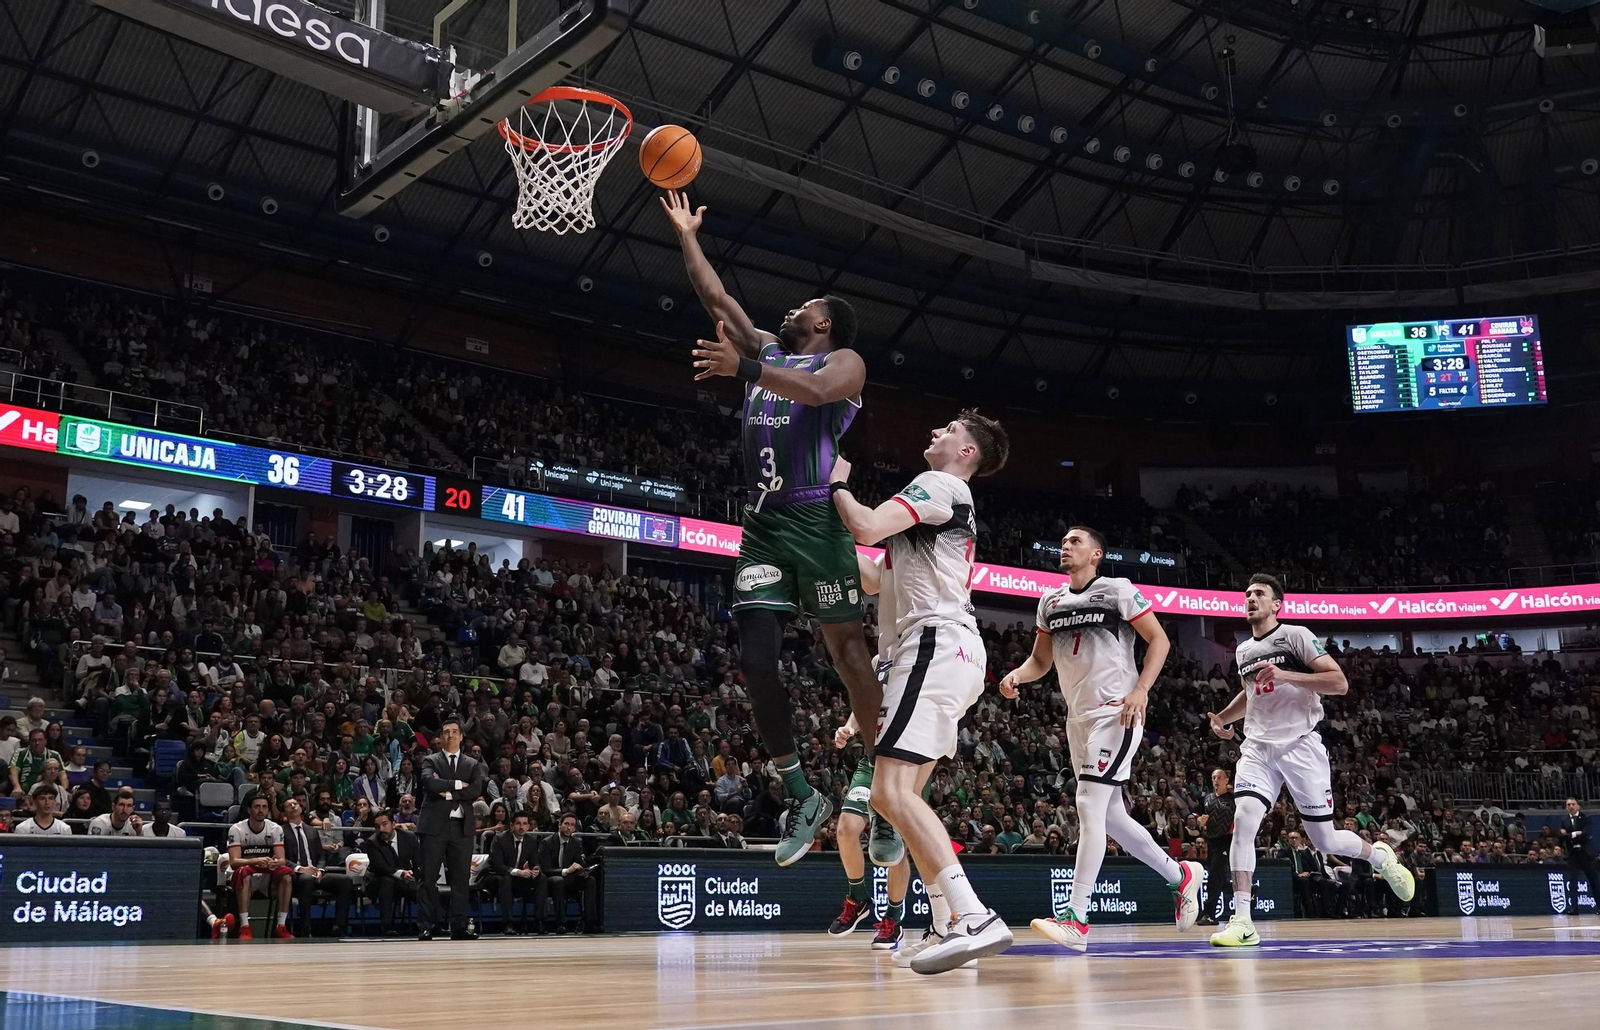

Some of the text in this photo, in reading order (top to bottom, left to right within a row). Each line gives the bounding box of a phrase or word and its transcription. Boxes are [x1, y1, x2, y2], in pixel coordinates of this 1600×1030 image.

[1410, 326, 1427, 338] 36
[1434, 324, 1450, 336] VS
[1458, 324, 1474, 336] 41
[1433, 358, 1464, 370] 3:28
[1440, 373, 1452, 382] 2T
[1429, 387, 1436, 396] 5
[1460, 385, 1467, 394] 4
[748, 411, 790, 428] málaga
[120, 433, 217, 470] UNICAJA
[267, 454, 300, 486] 36
[760, 447, 776, 478] 3
[348, 469, 408, 501] 3:28
[444, 487, 471, 510] 20
[501, 492, 526, 522] 41
[593, 507, 640, 526] COVIRAN
[588, 520, 640, 540] GRANADA
[679, 526, 718, 548] lcón
[1151, 556, 1175, 566] Unicaja
[989, 571, 1037, 592] Halcón
[817, 590, 843, 605] laga
[1178, 595, 1229, 612] Halcón
[1520, 593, 1583, 609] Halcón
[1284, 600, 1367, 615] Halcón viajes
[1398, 599, 1487, 614] Halcón viajes
[1072, 632, 1082, 656] 7
[16, 871, 108, 894] Ciudad
[705, 877, 759, 894] Ciudad
[1476, 881, 1500, 892] Ciudad
[704, 900, 781, 920] de Málaga
[912, 899, 929, 915] de
[1100, 897, 1137, 915] Málaga
[1477, 895, 1511, 909] de Málaga
[13, 901, 143, 927] de Málaga
